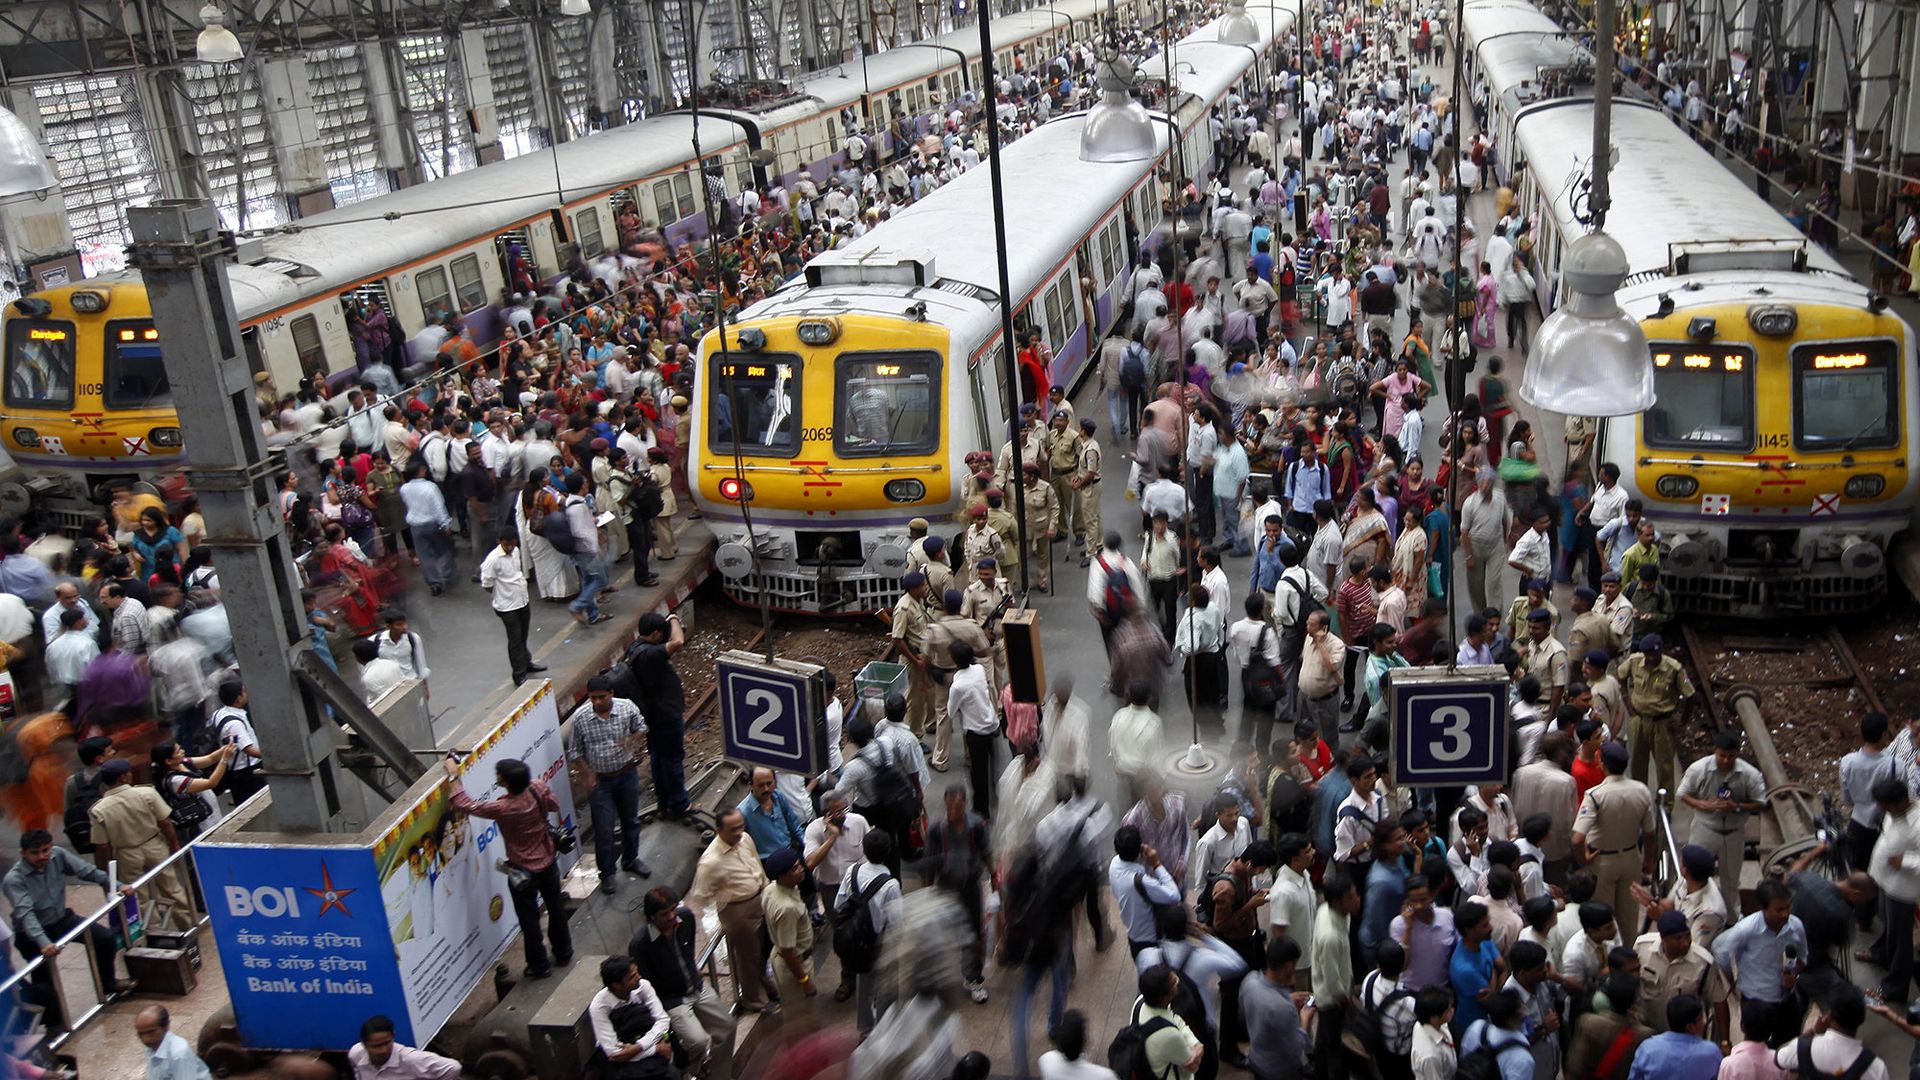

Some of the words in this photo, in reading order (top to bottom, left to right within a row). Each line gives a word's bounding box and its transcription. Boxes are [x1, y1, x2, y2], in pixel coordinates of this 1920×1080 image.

[261, 316, 285, 333] 1109C
[78, 384, 103, 395] 1109
[802, 427, 833, 442] 2069
[1758, 434, 1789, 448] 1145
[745, 688, 785, 746] 2
[1429, 705, 1472, 762] 3
[540, 754, 564, 783] oans
[224, 885, 301, 918] BOI
[312, 932, 362, 949] इंडिया
[241, 953, 272, 969] बैंक
[318, 955, 367, 973] इंडिया
[247, 976, 297, 993] Bank
[301, 978, 321, 993] of
[325, 979, 374, 995] India
